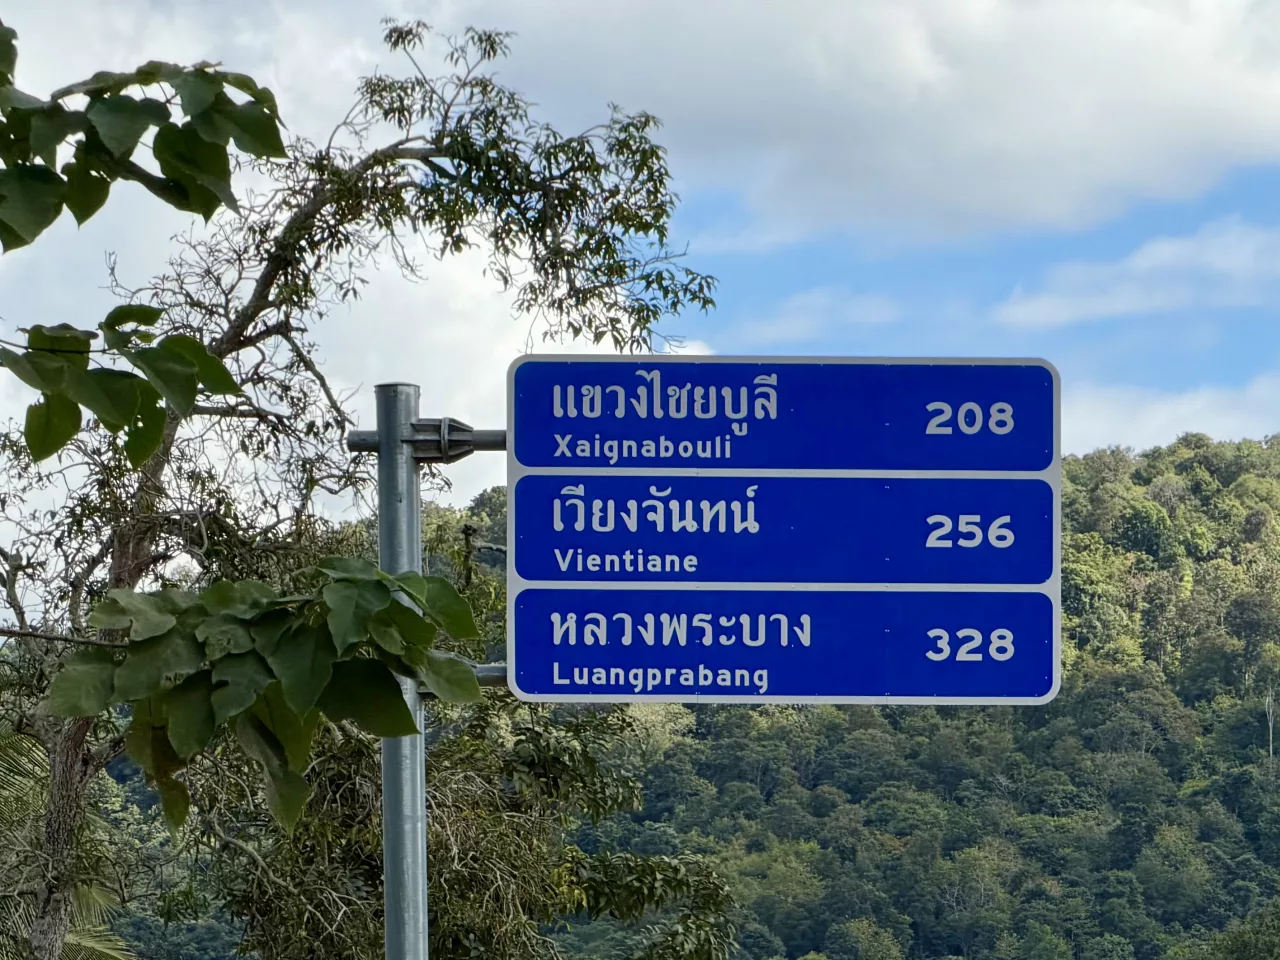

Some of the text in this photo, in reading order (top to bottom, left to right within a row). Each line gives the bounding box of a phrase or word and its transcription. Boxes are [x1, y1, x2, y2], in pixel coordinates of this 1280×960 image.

[553, 369, 778, 436] แขวงไชยบูลี
[925, 401, 1015, 435] 208
[553, 433, 731, 465] Xaignabouli
[553, 483, 760, 533] เวียงจันทน์
[926, 514, 1015, 548] 256
[553, 548, 698, 572] Vientiane
[550, 612, 811, 647] หลวงพระบาง
[925, 628, 1015, 661] 328
[553, 661, 769, 694] Luangprabang
